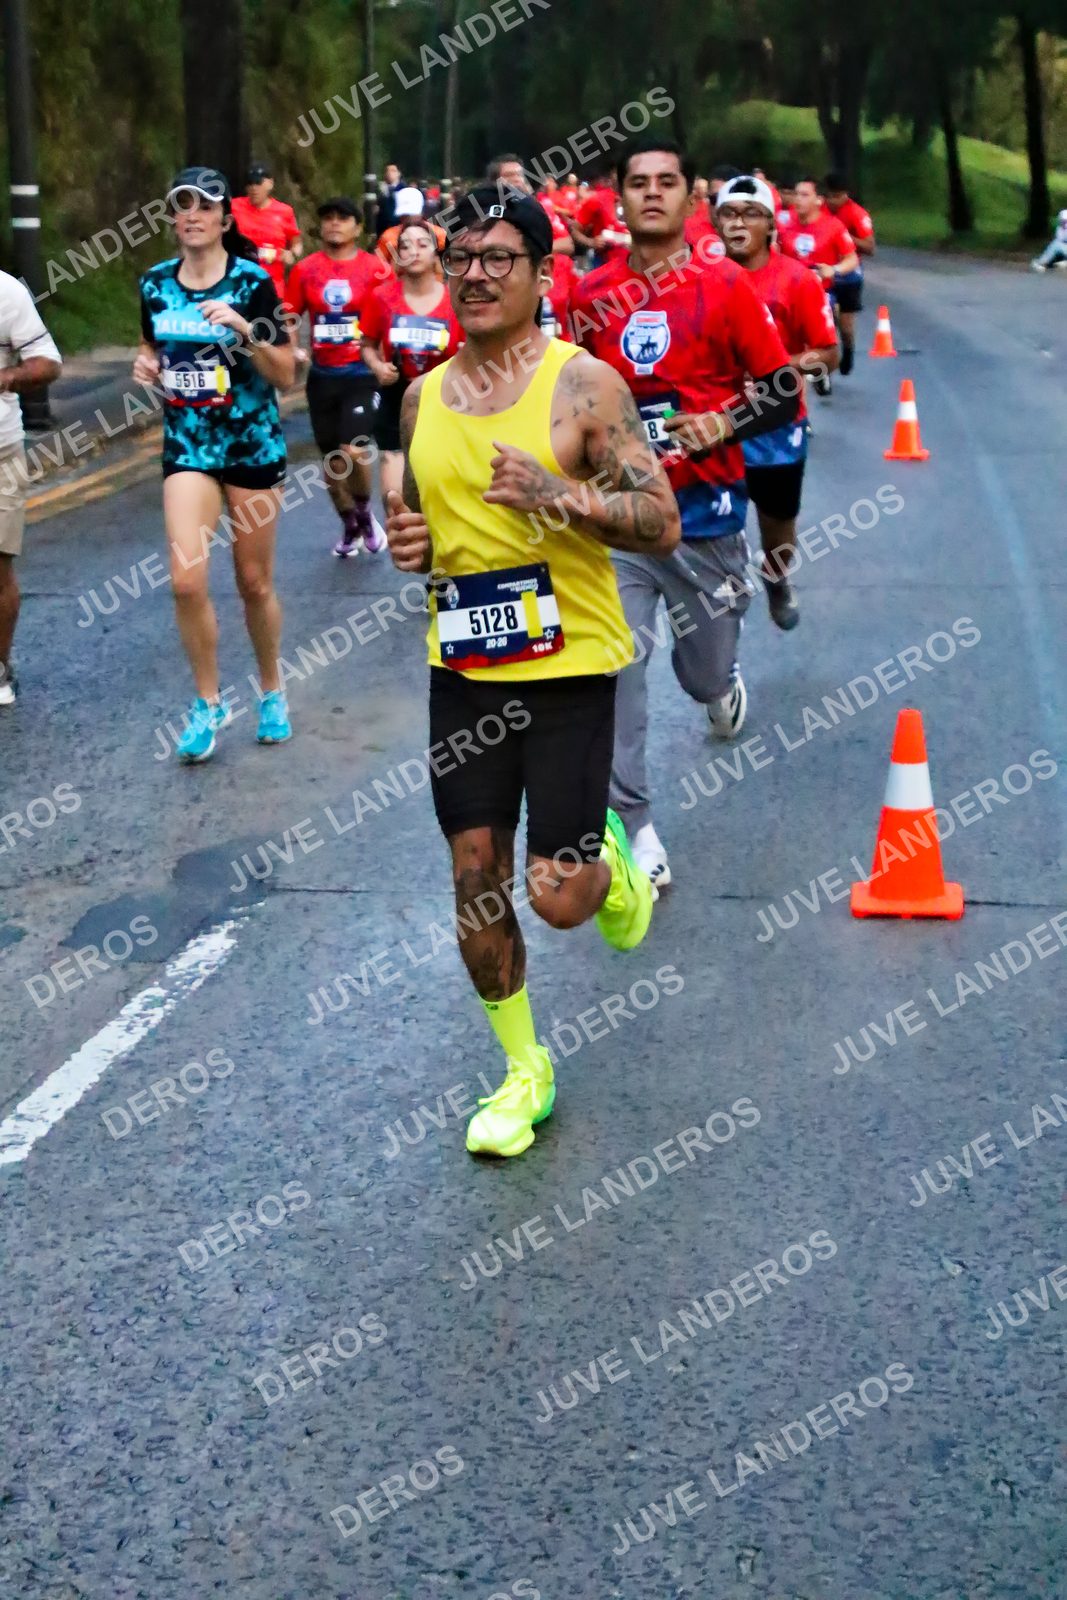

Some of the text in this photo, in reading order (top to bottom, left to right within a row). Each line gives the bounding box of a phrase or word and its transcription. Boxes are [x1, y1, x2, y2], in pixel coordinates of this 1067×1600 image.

[175, 372, 205, 388] 5516
[469, 605, 518, 635] 5128
[532, 642, 553, 653] 10K
